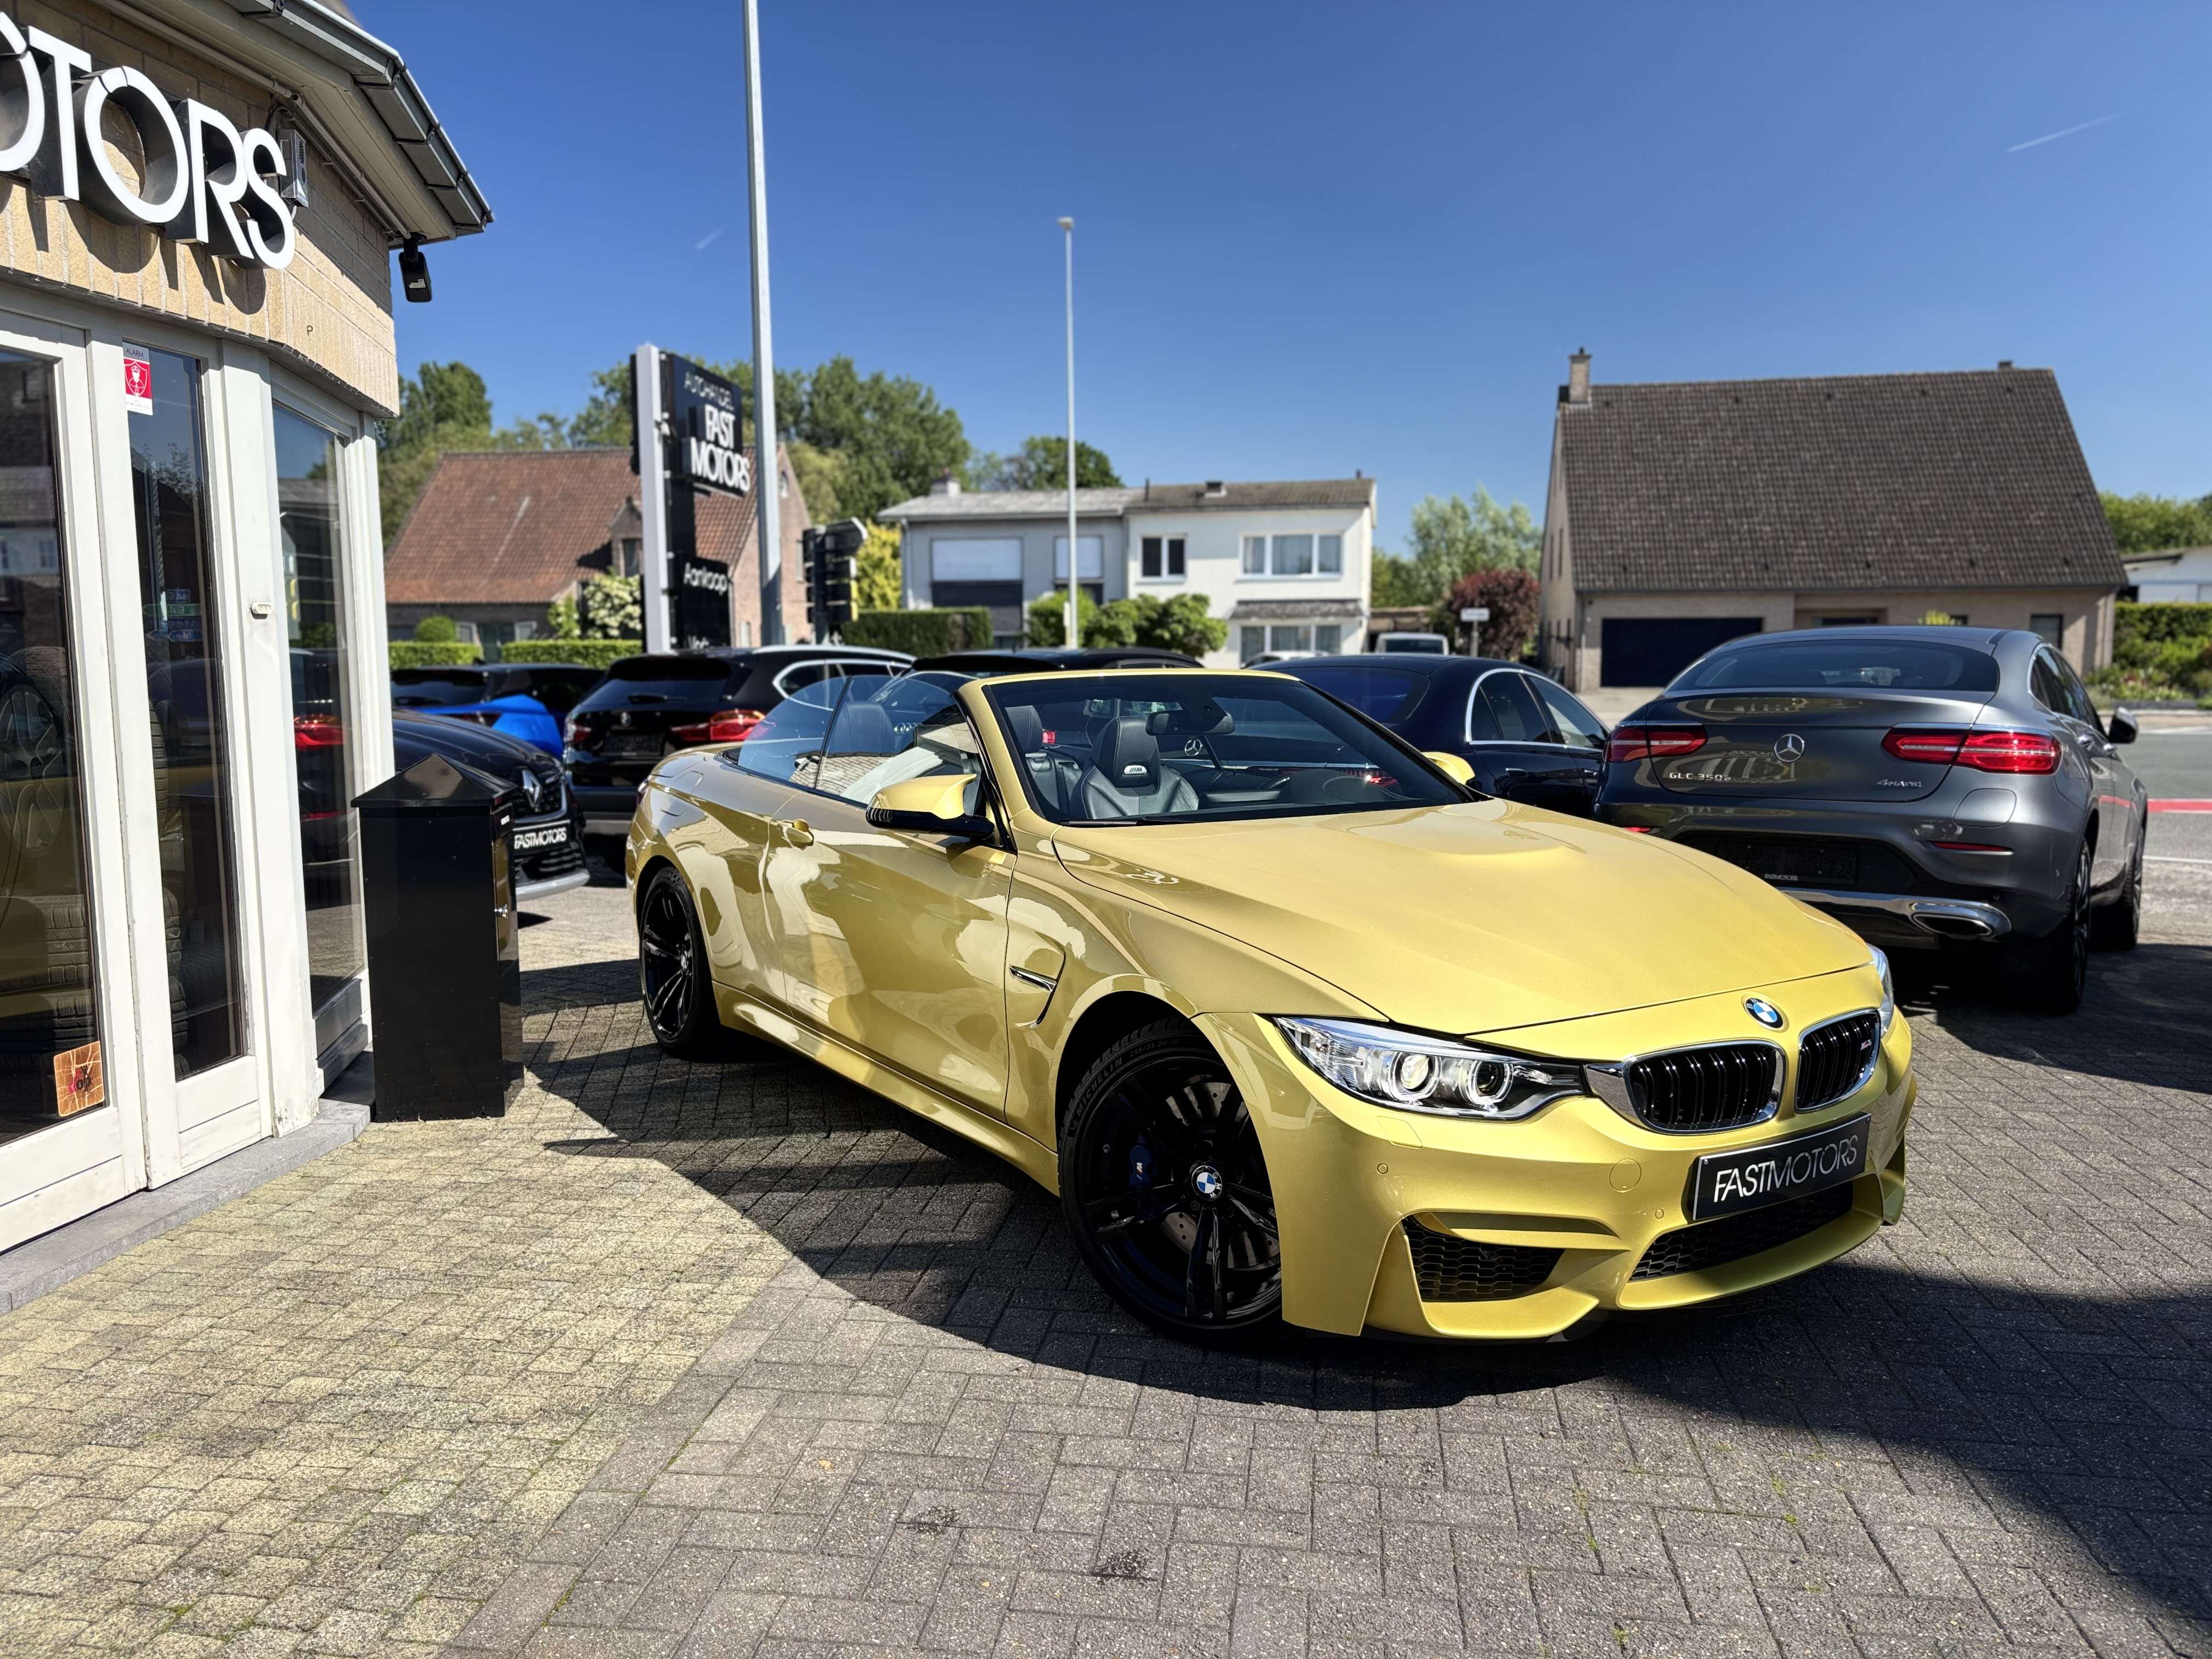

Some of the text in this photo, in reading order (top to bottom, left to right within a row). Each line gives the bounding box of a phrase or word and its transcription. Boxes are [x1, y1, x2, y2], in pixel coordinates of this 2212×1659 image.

[126, 348, 144, 358] ALARM
[704, 403, 736, 450] FAST
[690, 437, 751, 492] MOTORS
[1877, 778, 1922, 787] 4MATIC
[514, 827, 567, 850] FASTMOTORS
[1764, 873, 1798, 882] FASTMOTORS
[1076, 1057, 1124, 1118] MICHELIN
[1713, 1134, 1859, 1203] FASTMOTORS
